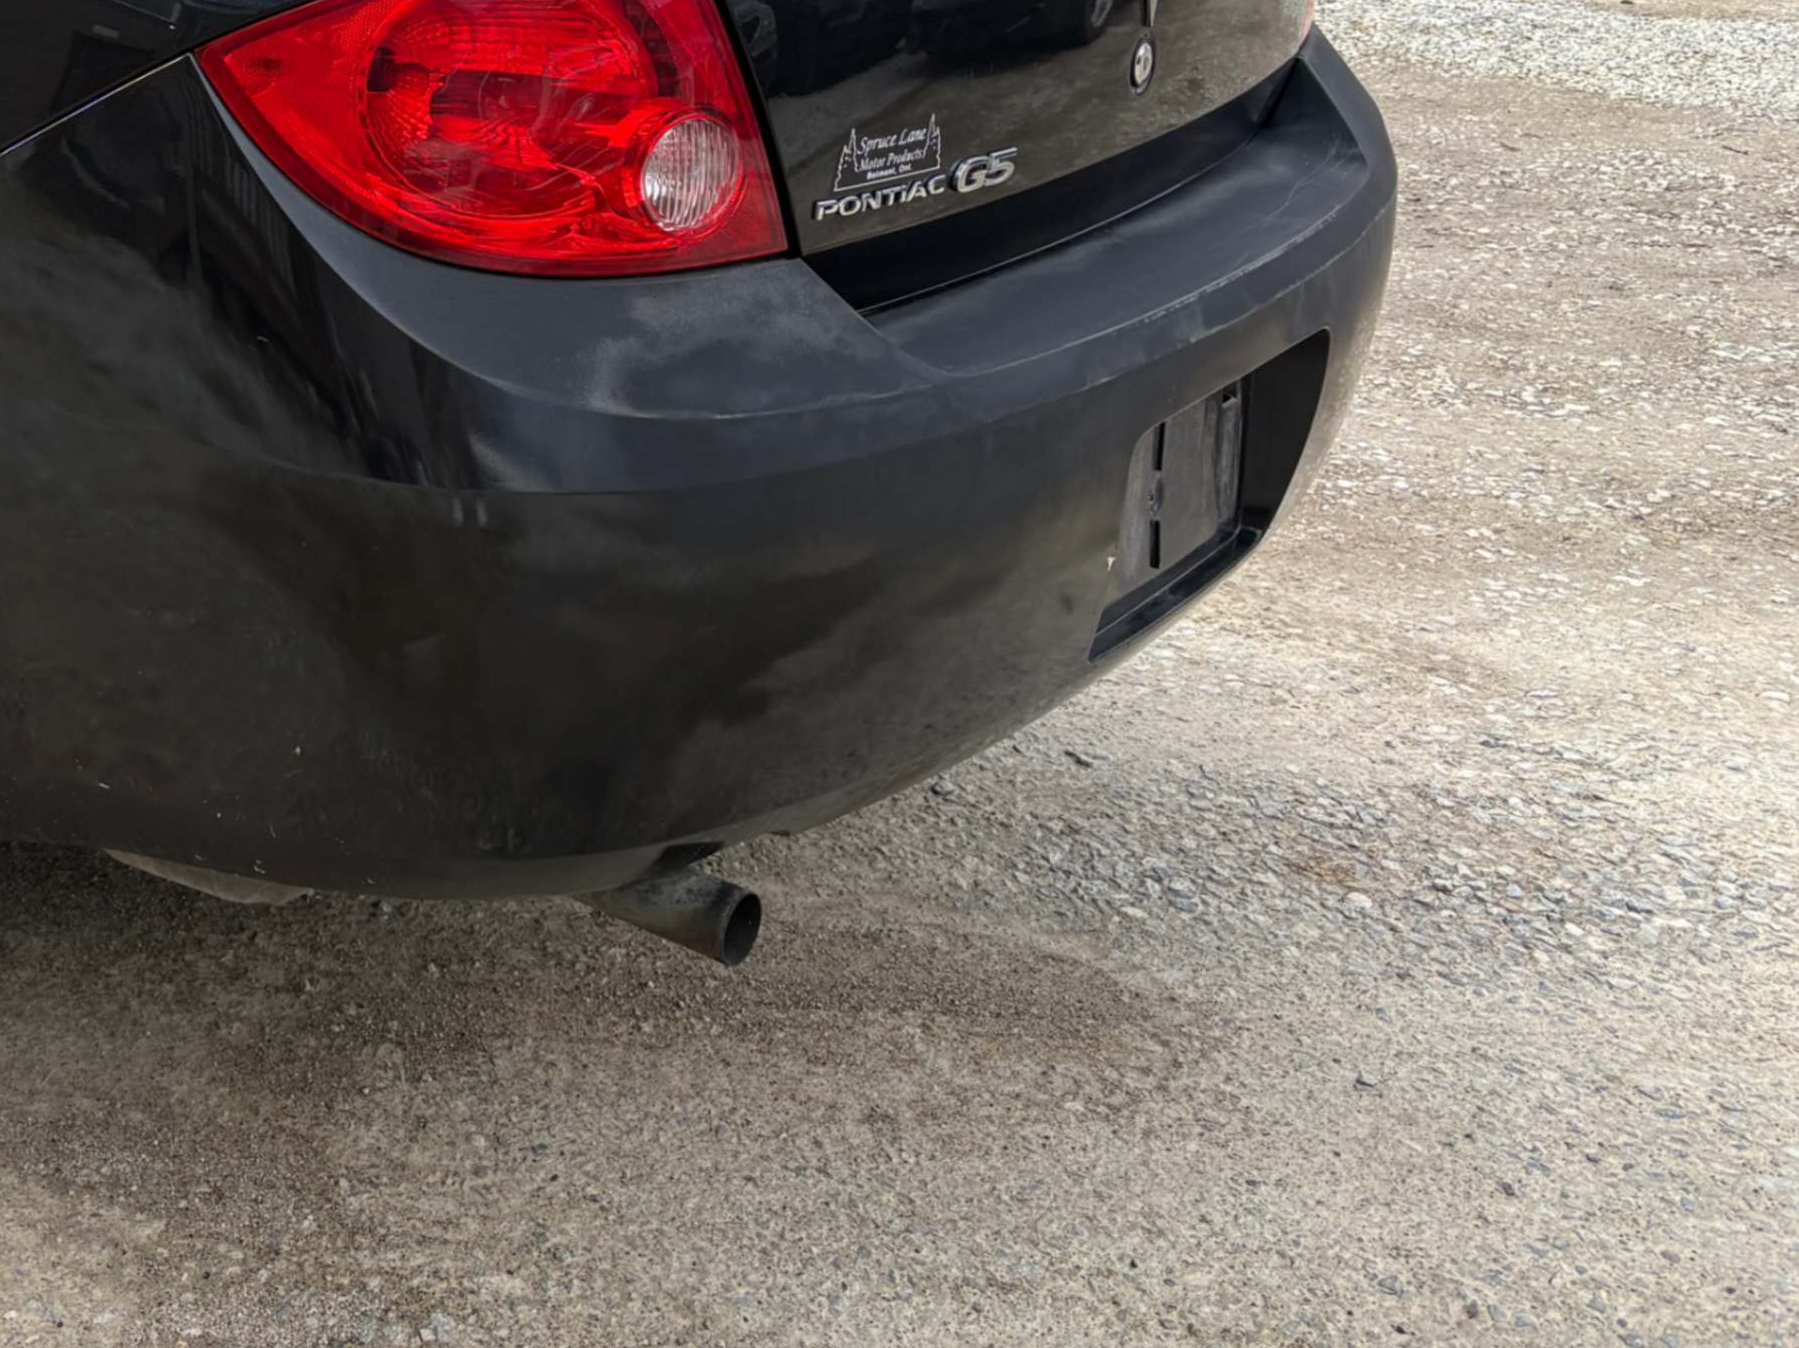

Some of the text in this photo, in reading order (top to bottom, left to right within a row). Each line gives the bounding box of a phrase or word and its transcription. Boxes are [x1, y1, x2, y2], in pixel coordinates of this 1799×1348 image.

[856, 127, 928, 157] Spruce Lane
[859, 148, 923, 172] Motor Products
[815, 146, 1018, 221] PONTIAC G5
